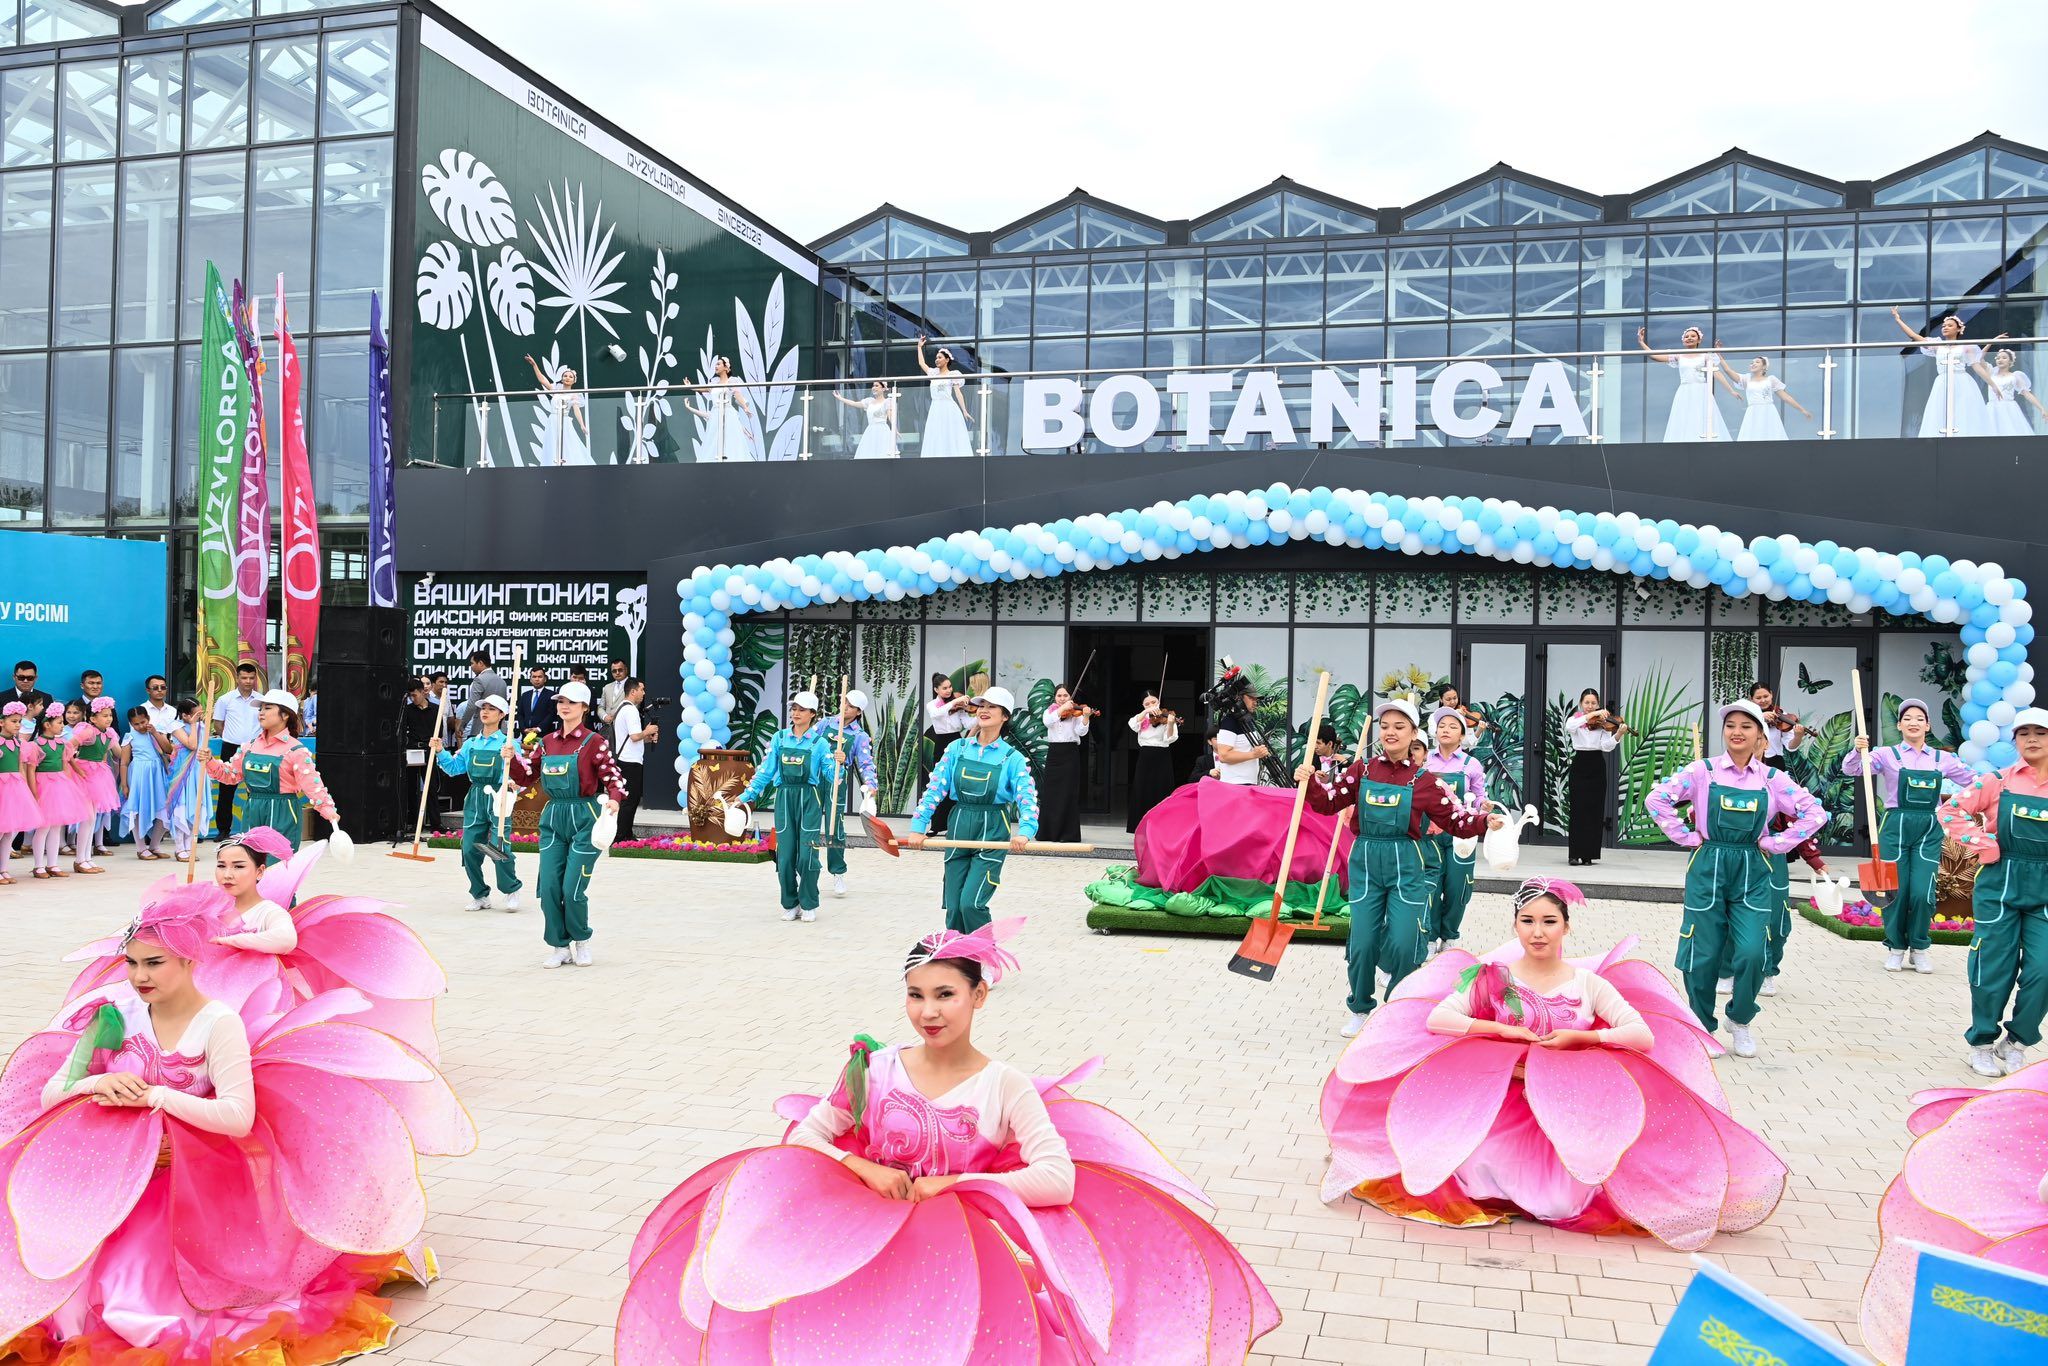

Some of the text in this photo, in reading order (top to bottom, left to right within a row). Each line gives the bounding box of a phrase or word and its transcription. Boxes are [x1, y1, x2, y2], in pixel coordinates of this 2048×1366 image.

[527, 88, 588, 140] BOTANICA
[627, 152, 686, 199] QYZYLORDA
[1022, 361, 1591, 450] BOTANICA
[413, 583, 609, 606] ВАШИНГТОНИЯ
[15, 602, 69, 623] РӘСІМІ
[413, 609, 609, 627] ДИКСОНИЯ ФИНИК РОБЕЛЕНА
[413, 627, 609, 638] ЮККА ФАКСОНА БУГЕНВИЛЛЕЯ СИНГОНИУМ
[413, 638, 529, 664] ОРХИДЕЯ
[536, 639, 609, 652] РИПСАЛИС
[536, 653, 609, 665] ЮККА ШТАМБ
